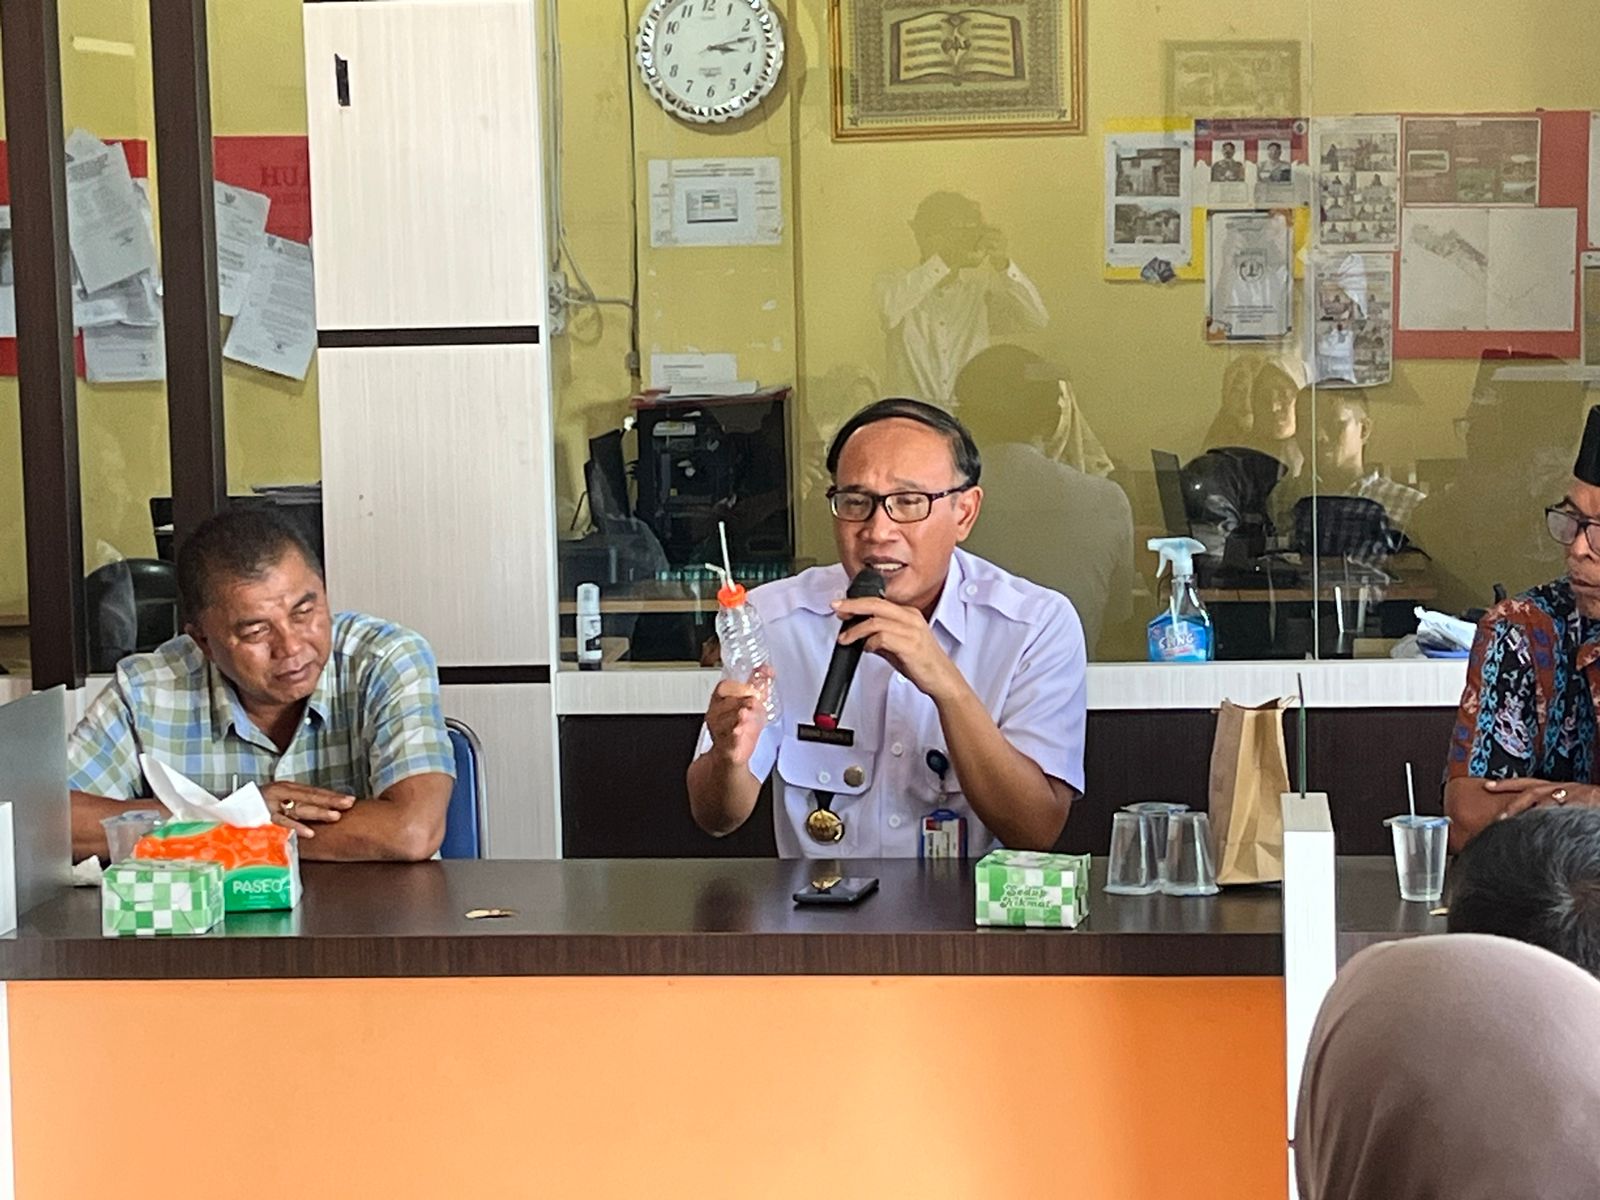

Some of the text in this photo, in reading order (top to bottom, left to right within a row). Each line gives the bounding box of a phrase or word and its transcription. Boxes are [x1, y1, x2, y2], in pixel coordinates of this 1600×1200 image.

[681, 4, 693, 18] 11
[727, 3, 733, 16] 1
[666, 21, 679, 34] 10
[741, 18, 751, 32] 2
[664, 43, 673, 56] 9
[669, 64, 678, 78] 8
[743, 62, 752, 75] 4
[685, 80, 693, 93] 7
[706, 84, 715, 98] 6
[729, 78, 737, 91] 5
[232, 878, 283, 895] PASEO
